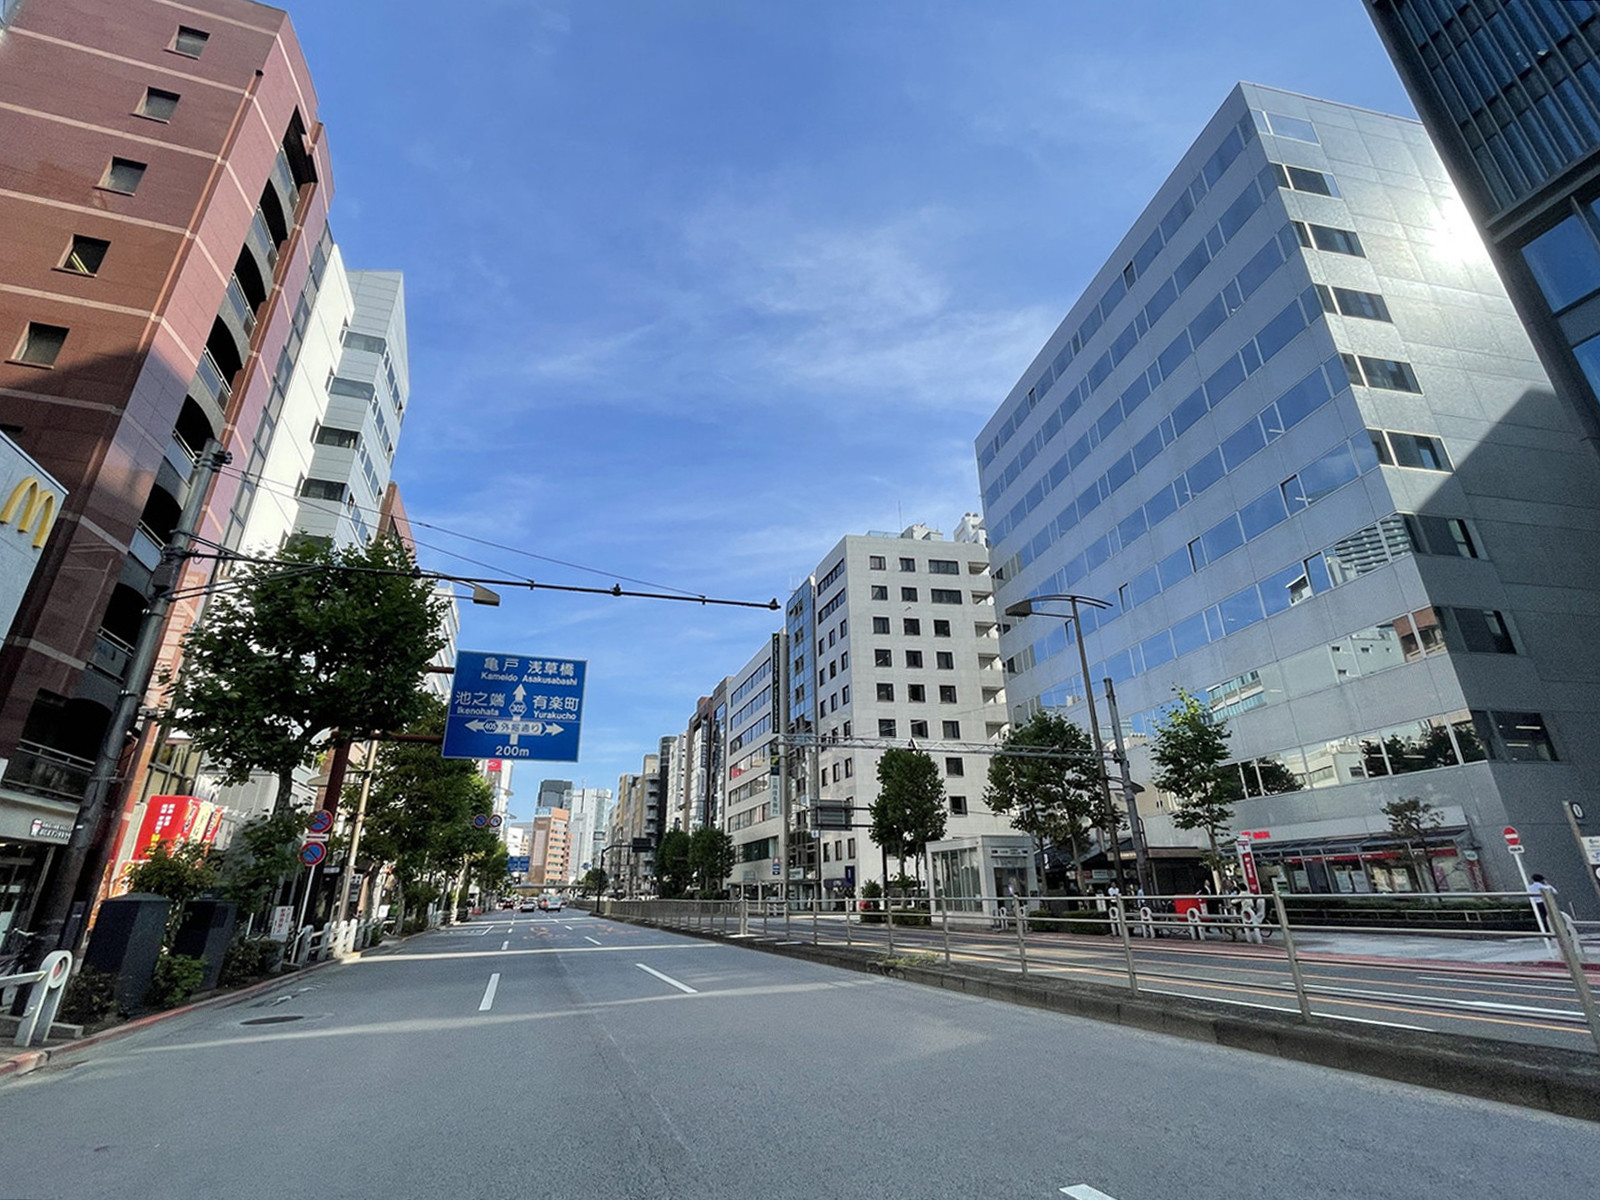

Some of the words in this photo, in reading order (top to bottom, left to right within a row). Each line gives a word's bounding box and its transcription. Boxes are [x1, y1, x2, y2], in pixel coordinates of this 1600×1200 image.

[484, 657, 519, 671] 亀戸
[528, 660, 574, 677] 浅草橋
[481, 671, 518, 682] Kameido
[522, 674, 578, 686] Asakusabashi
[455, 691, 506, 707] 池之端
[532, 695, 580, 712] 有楽町
[457, 706, 499, 716] Ikenohata
[533, 710, 577, 720] Yurakucho
[500, 722, 540, 733] 外堀通り
[495, 745, 530, 757] 200m
